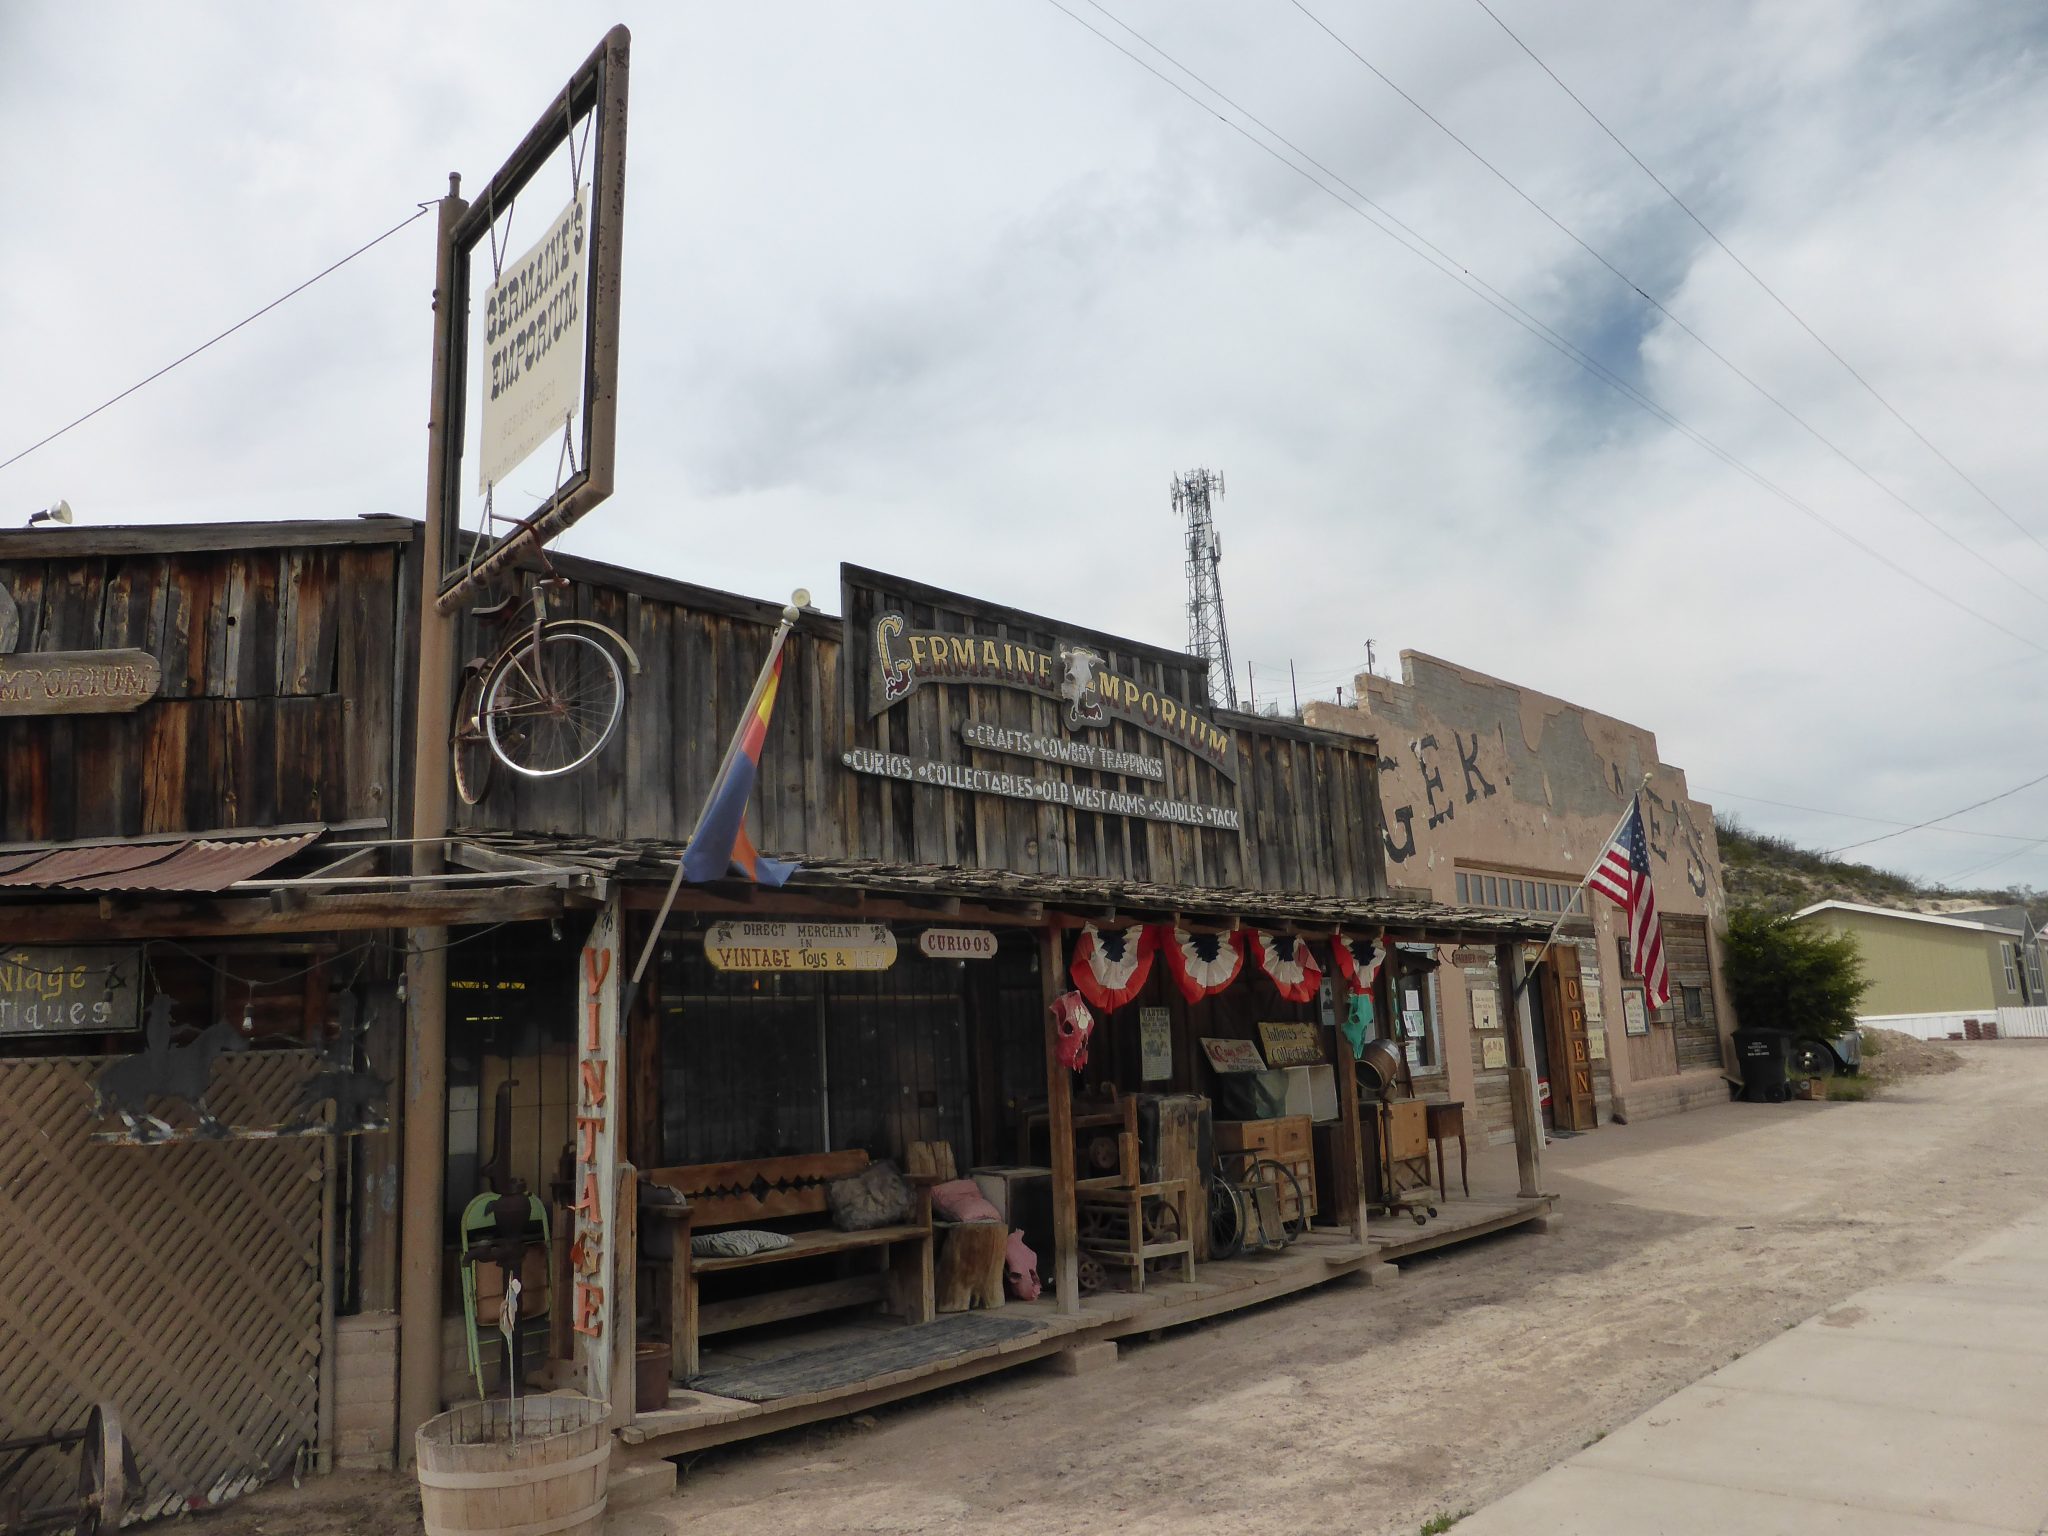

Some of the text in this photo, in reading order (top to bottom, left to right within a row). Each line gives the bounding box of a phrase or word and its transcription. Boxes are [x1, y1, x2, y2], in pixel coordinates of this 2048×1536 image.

[486, 203, 584, 345] GERMAINE'S
[490, 271, 579, 402] EMPORIUM
[0, 661, 153, 701] MPORIUM
[876, 613, 1055, 700] GERMAINE
[976, 726, 1163, 780] CRAFTS COWBOY TRAPPINGS
[852, 751, 1239, 829] CURIOS COLLECTABLES OLD WEST ARMS SADDLES TACK
[717, 948, 792, 968] VINTAGE
[798, 949, 828, 969] Toys
[836, 953, 846, 966] &
[743, 923, 860, 938] DIRECT MERCHANT
[800, 938, 813, 948] IN
[1567, 980, 1590, 1094] OPEN
